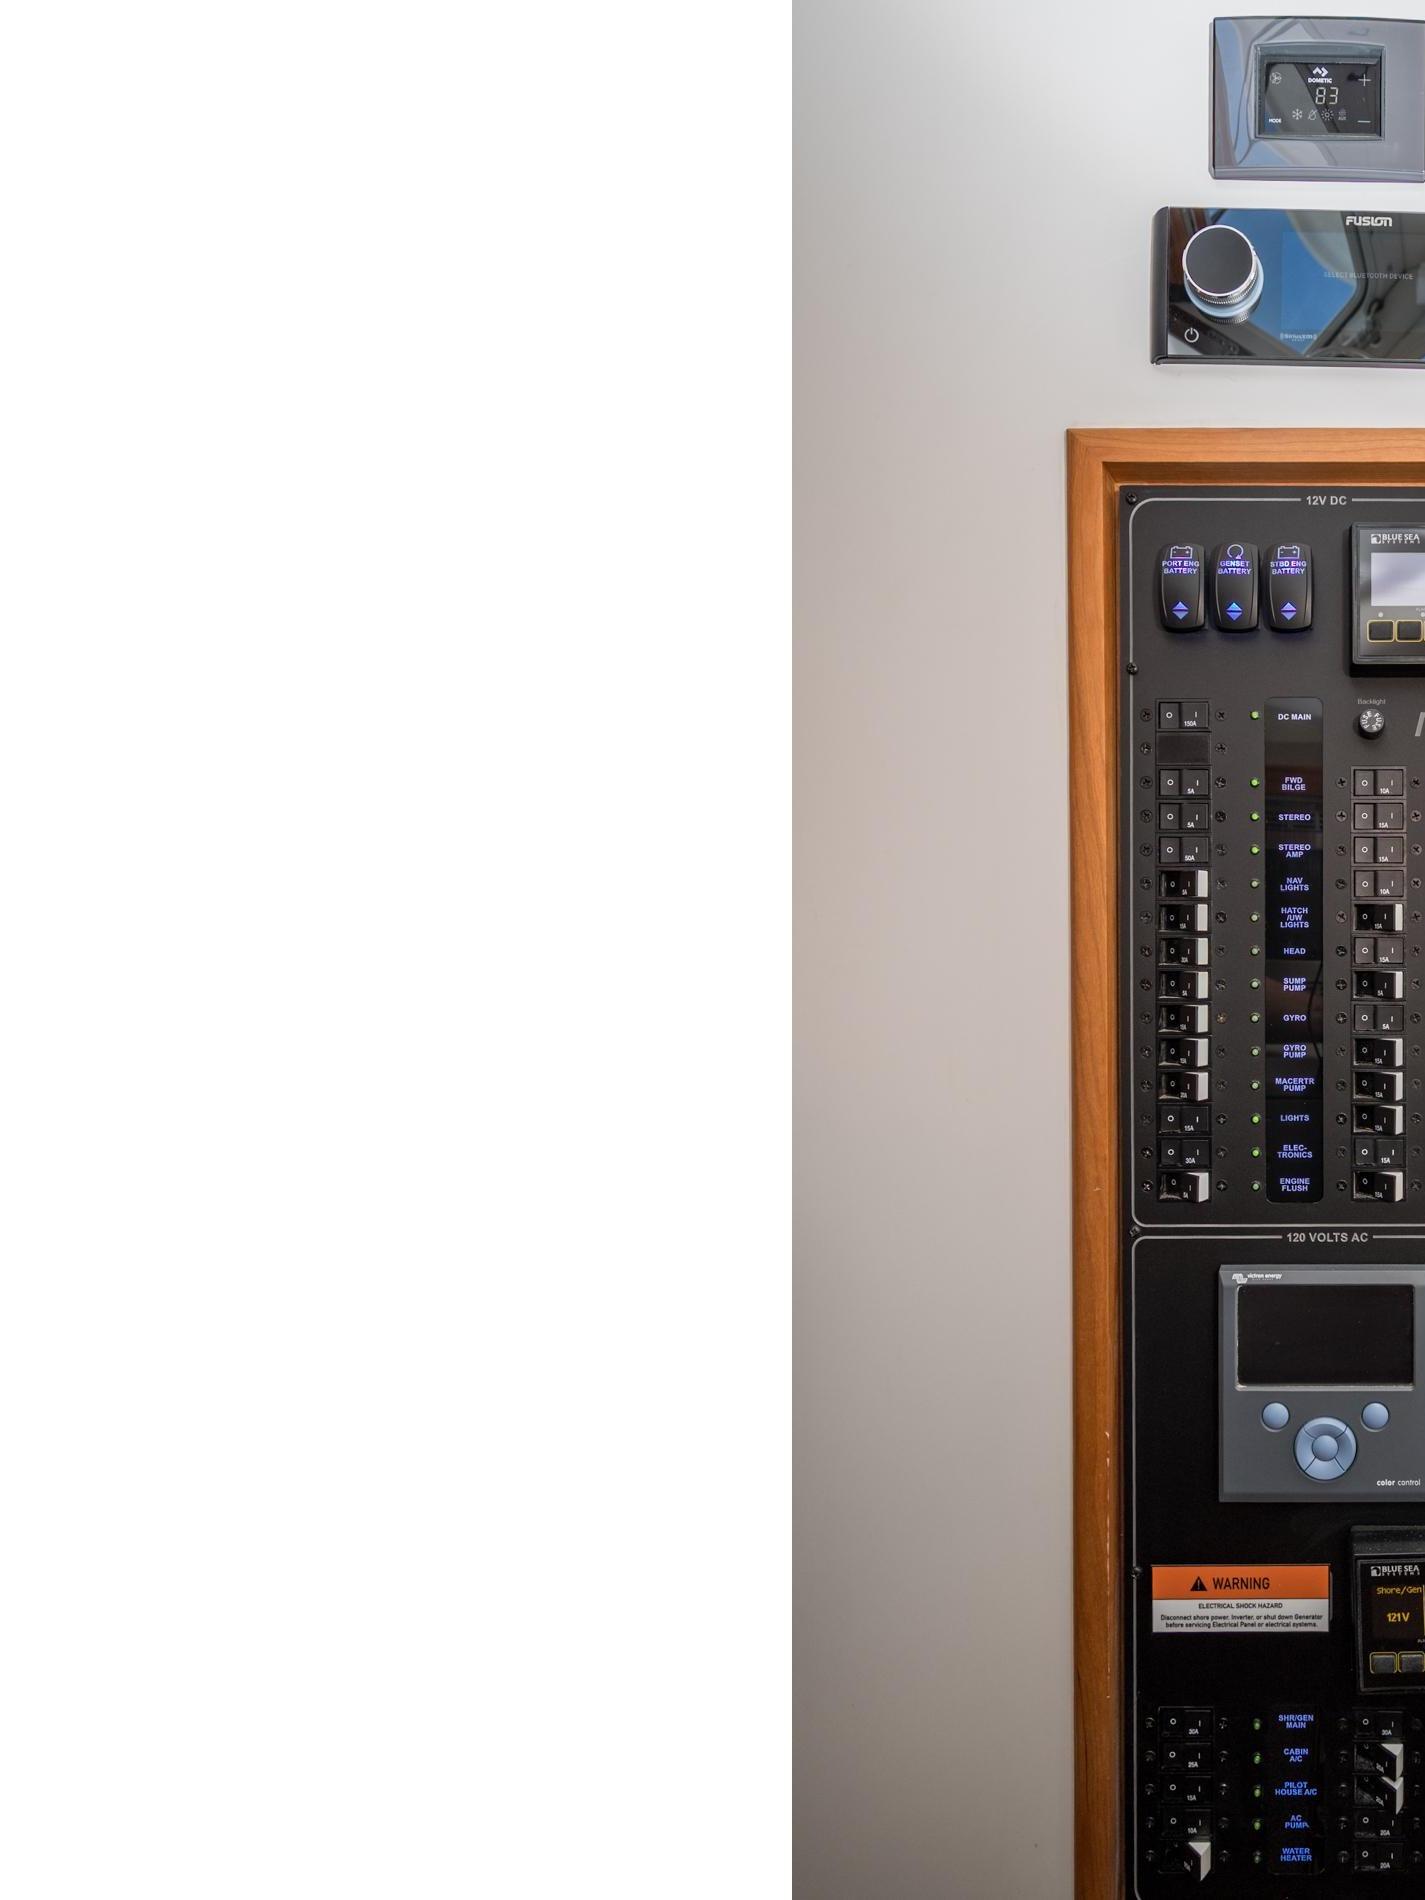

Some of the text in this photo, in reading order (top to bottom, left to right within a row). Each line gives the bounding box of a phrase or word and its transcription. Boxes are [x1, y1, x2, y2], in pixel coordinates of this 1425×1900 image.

[1315, 87, 1338, 104] 83
[1307, 496, 1347, 505] 12V DC
[1287, 1233, 1368, 1242] 120 VOLTS AC
[1213, 1577, 1270, 1589] WARNING
[1377, 1586, 1422, 1595] Shore/Gen
